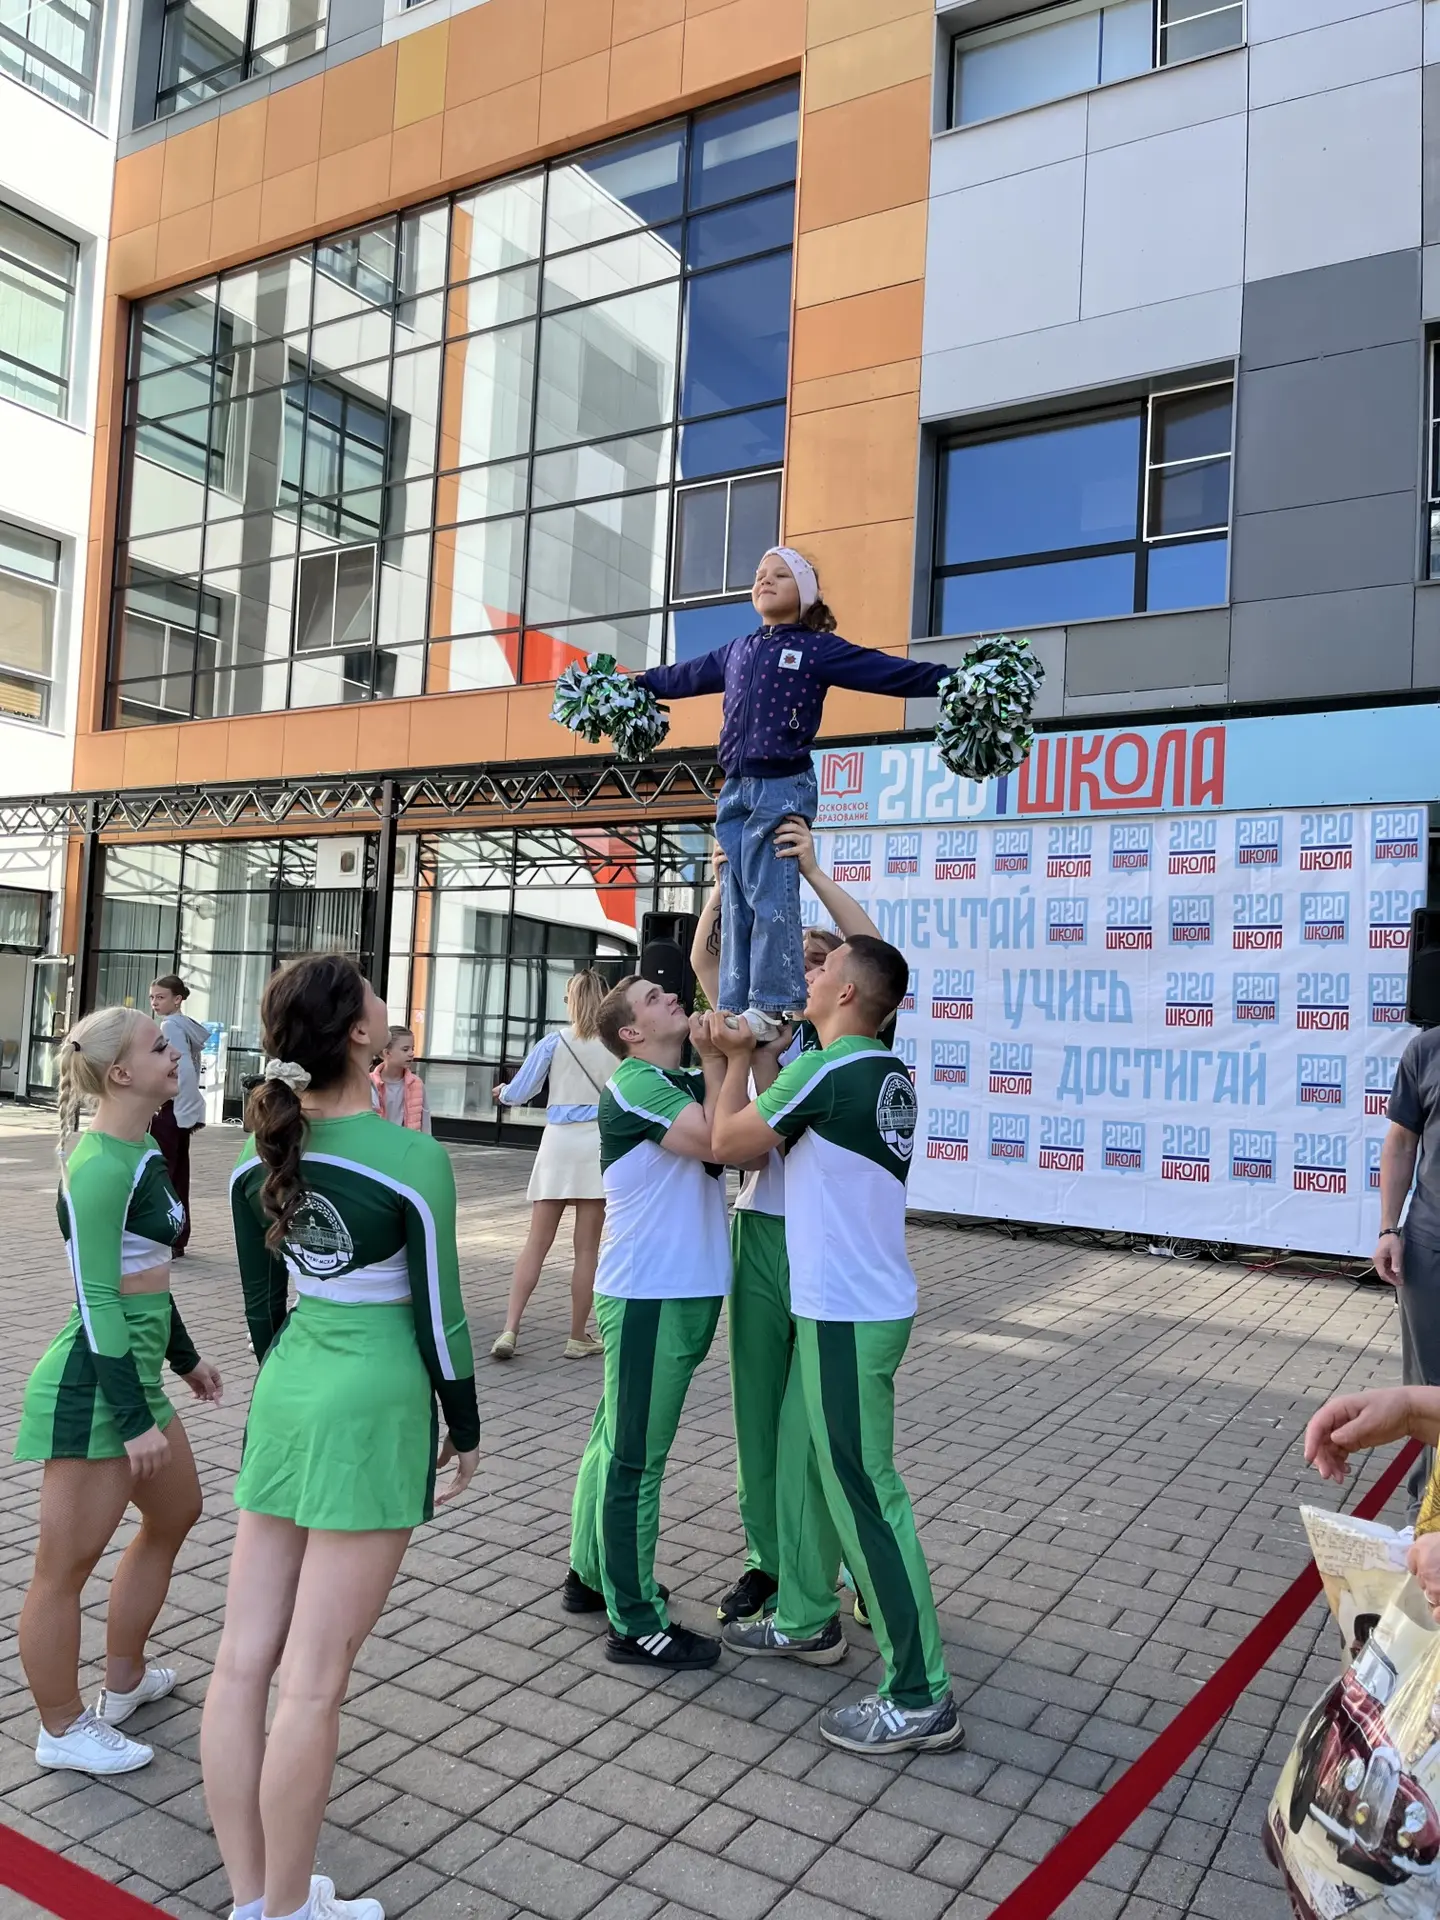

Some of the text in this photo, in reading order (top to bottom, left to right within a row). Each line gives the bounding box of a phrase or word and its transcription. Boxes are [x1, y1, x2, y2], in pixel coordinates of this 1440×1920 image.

[1017, 726, 1226, 814] ШКОЛА
[819, 802, 868, 812] ОСКОВСКОЕ
[1169, 819, 1217, 849] 2120
[1239, 820, 1279, 845] 2120
[1300, 812, 1353, 844] 2120
[1375, 812, 1419, 839] 2120
[834, 834, 872, 859] 2120
[888, 835, 919, 856] 2120
[936, 830, 978, 857] 2120
[995, 828, 1029, 854] 2120
[1049, 826, 1092, 853] 2120
[1113, 827, 1149, 850] 2120
[1112, 854, 1148, 868] ШКОЛА
[1239, 849, 1278, 864] ШКОЛА
[1300, 850, 1352, 871] ШКОЛА
[1375, 843, 1417, 859] ШКОЛА
[833, 866, 871, 881] ШКОЛА
[888, 860, 917, 873] ШКОЛА
[935, 863, 976, 880] ШКОЛА
[995, 857, 1028, 871] ШКОЛА
[1047, 860, 1091, 878] ШКОЛА
[1168, 856, 1216, 875] ШКОЛА
[876, 885, 1036, 950] МЕЧТАЙ
[1050, 901, 1084, 922] 2120
[1106, 896, 1152, 924] 2120
[1172, 899, 1210, 922] 2120
[1233, 893, 1283, 924] 2120
[1305, 895, 1345, 920] 2120
[1049, 928, 1083, 941] ШКОЛА
[1106, 932, 1152, 950] ШКОЛА
[1172, 927, 1210, 941] ШКОЛА
[1232, 931, 1283, 949] ШКОЛА
[1304, 925, 1344, 940] ШКОЛА
[933, 969, 975, 996] 2120
[1166, 971, 1214, 1001] 2120
[1236, 976, 1276, 1001] 2120
[1297, 973, 1350, 1004] 2120
[1373, 977, 1407, 1002] 212
[1002, 969, 1133, 1030] УЧИСЬ
[932, 1002, 973, 1020] ШКОЛА
[1165, 1008, 1213, 1027] ШКОЛА
[1236, 1005, 1275, 1020] ШКОЛА
[1296, 1011, 1349, 1030] ШКОЛА
[1373, 1008, 1407, 1022] ШКОЛ
[934, 1043, 967, 1065] 2120
[990, 1042, 1033, 1070] 2120
[934, 1069, 966, 1083] ШКОЛА
[1056, 1041, 1267, 1106] ДОСТИГАЙ
[1300, 1057, 1342, 1083] 2120
[989, 1076, 1032, 1095] ШКОЛА
[1300, 1087, 1341, 1104] ШКОЛА
[928, 1108, 970, 1137] 2120
[992, 1116, 1025, 1140] 2120
[1040, 1115, 1085, 1147] 2120
[1105, 1124, 1142, 1149] 2120
[1162, 1124, 1210, 1156] 2120
[1233, 1133, 1272, 1158] 2120
[926, 1142, 968, 1162] ШКОЛА
[991, 1143, 1025, 1158] ШКОЛА
[1105, 1152, 1141, 1169] ШКОЛА
[1294, 1133, 1347, 1166] 2120
[1039, 1151, 1084, 1172] ШКОЛА
[1161, 1161, 1209, 1182] ШКОЛА
[1232, 1162, 1272, 1179] ШКОЛА
[1293, 1171, 1346, 1194] ШКОЛА
